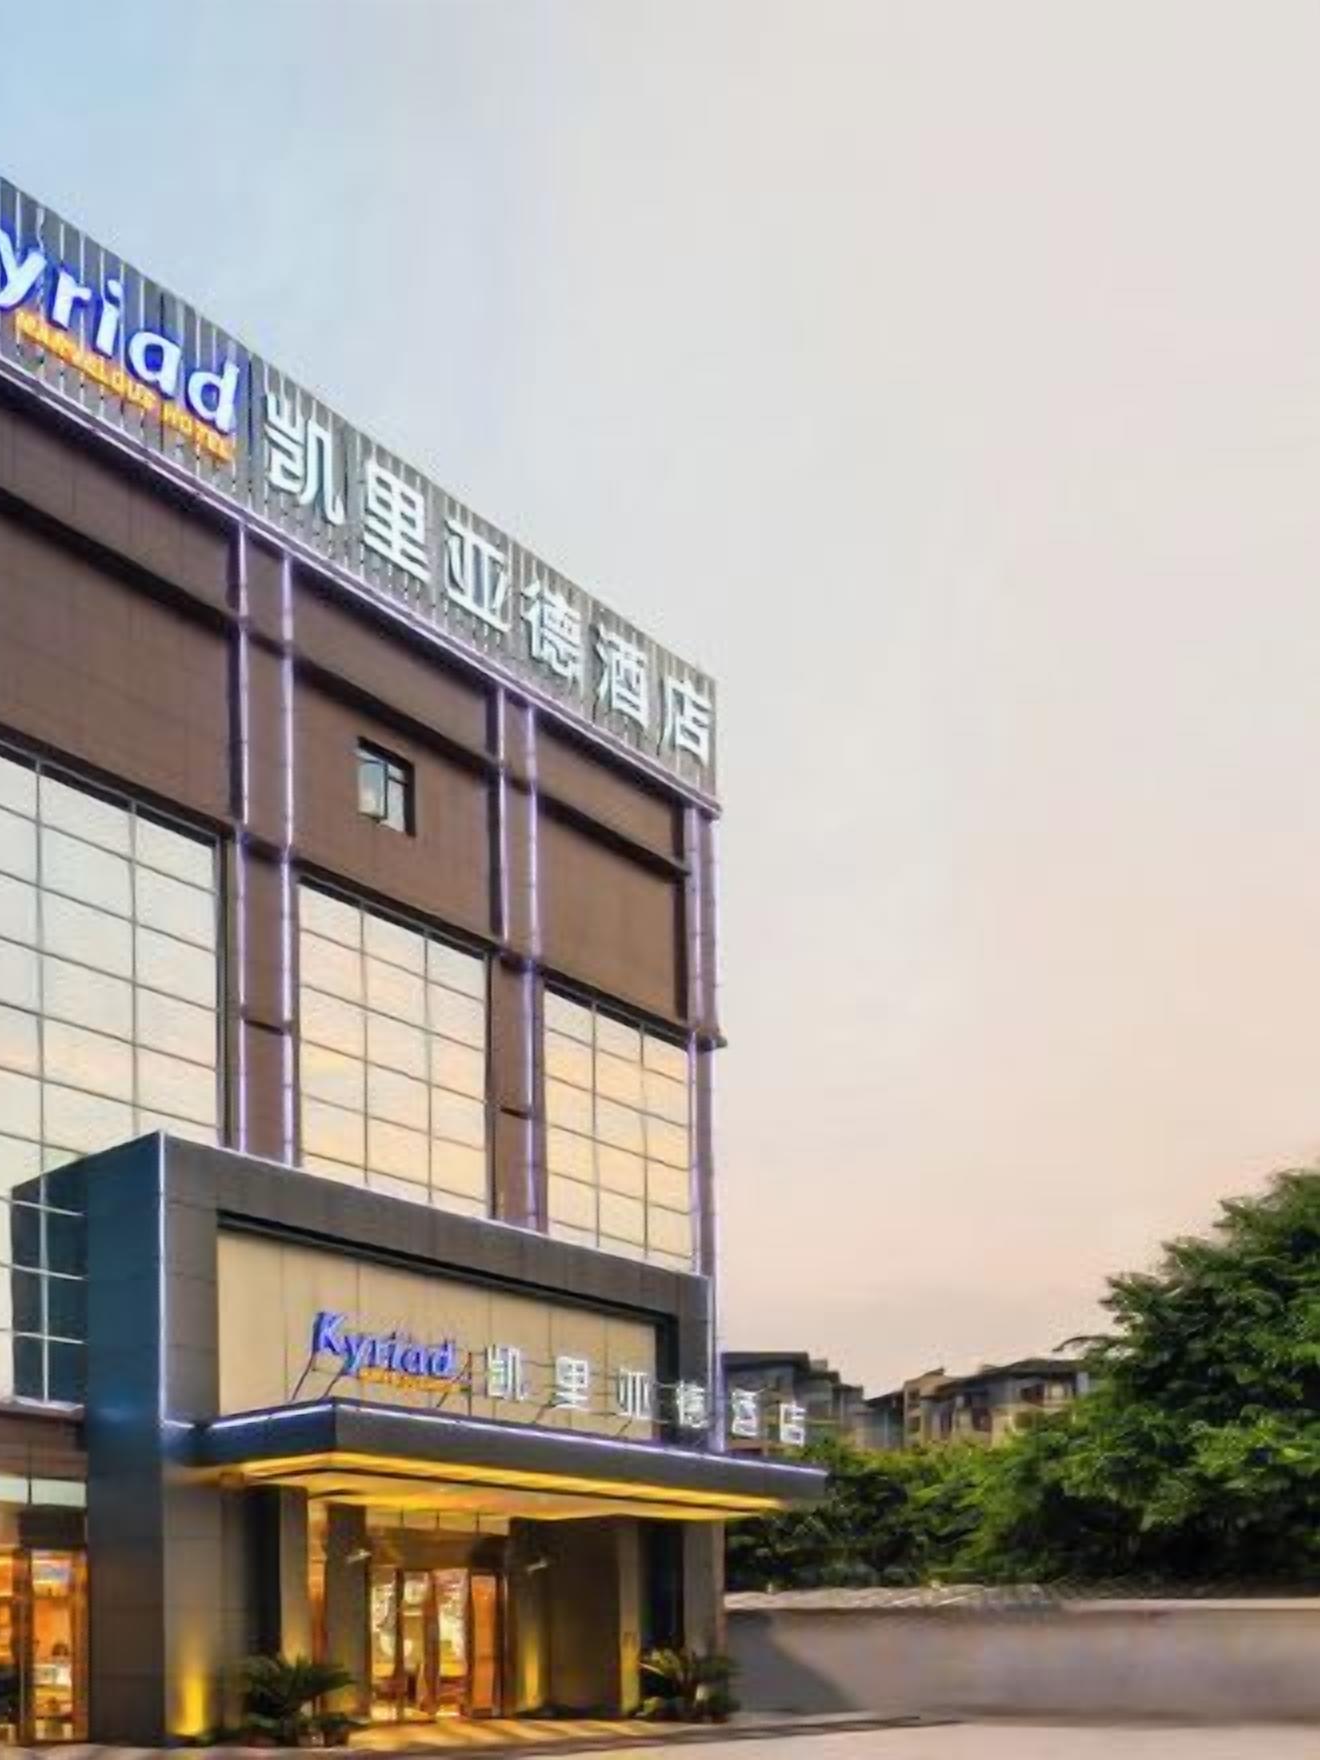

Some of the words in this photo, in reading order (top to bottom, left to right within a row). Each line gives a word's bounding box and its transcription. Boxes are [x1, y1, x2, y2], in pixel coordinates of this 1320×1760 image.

[163, 400, 234, 464] HOTEL
[264, 390, 714, 766] 凯里亚德酒店
[312, 1312, 457, 1380] Kyriad
[486, 1344, 806, 1447] 凯里亚德酒店
